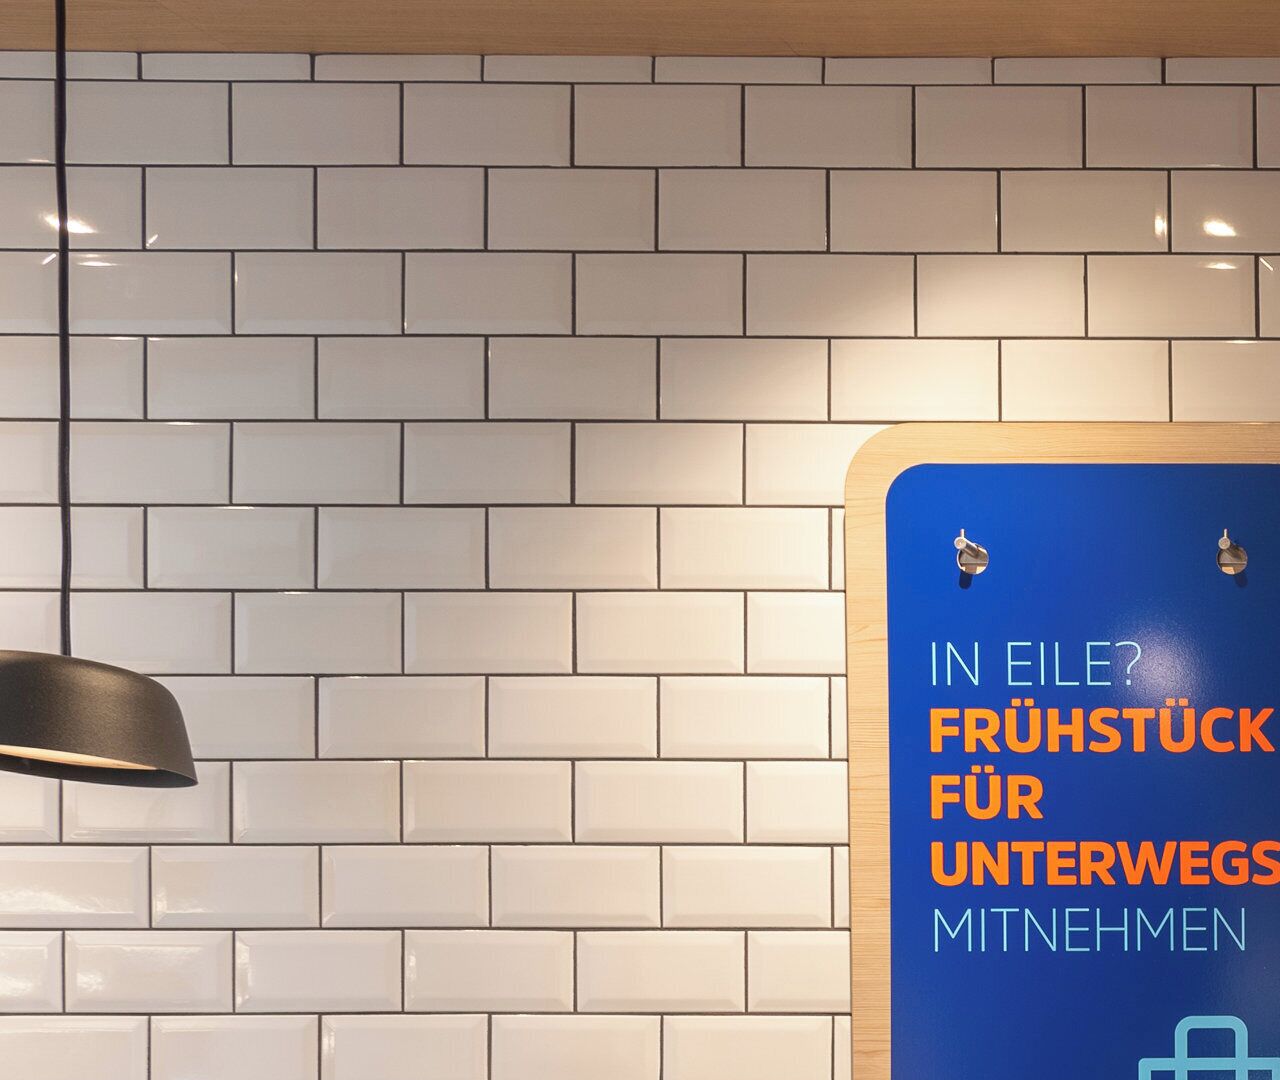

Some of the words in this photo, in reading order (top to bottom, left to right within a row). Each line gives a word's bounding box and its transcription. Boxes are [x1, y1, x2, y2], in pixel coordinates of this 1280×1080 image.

[931, 641, 979, 686] IN
[1007, 640, 1142, 686] EILE?
[929, 697, 1276, 754] FRÜHSTÜCK
[929, 764, 1044, 821] FÜR
[934, 907, 1246, 953] MITNEHMEN
